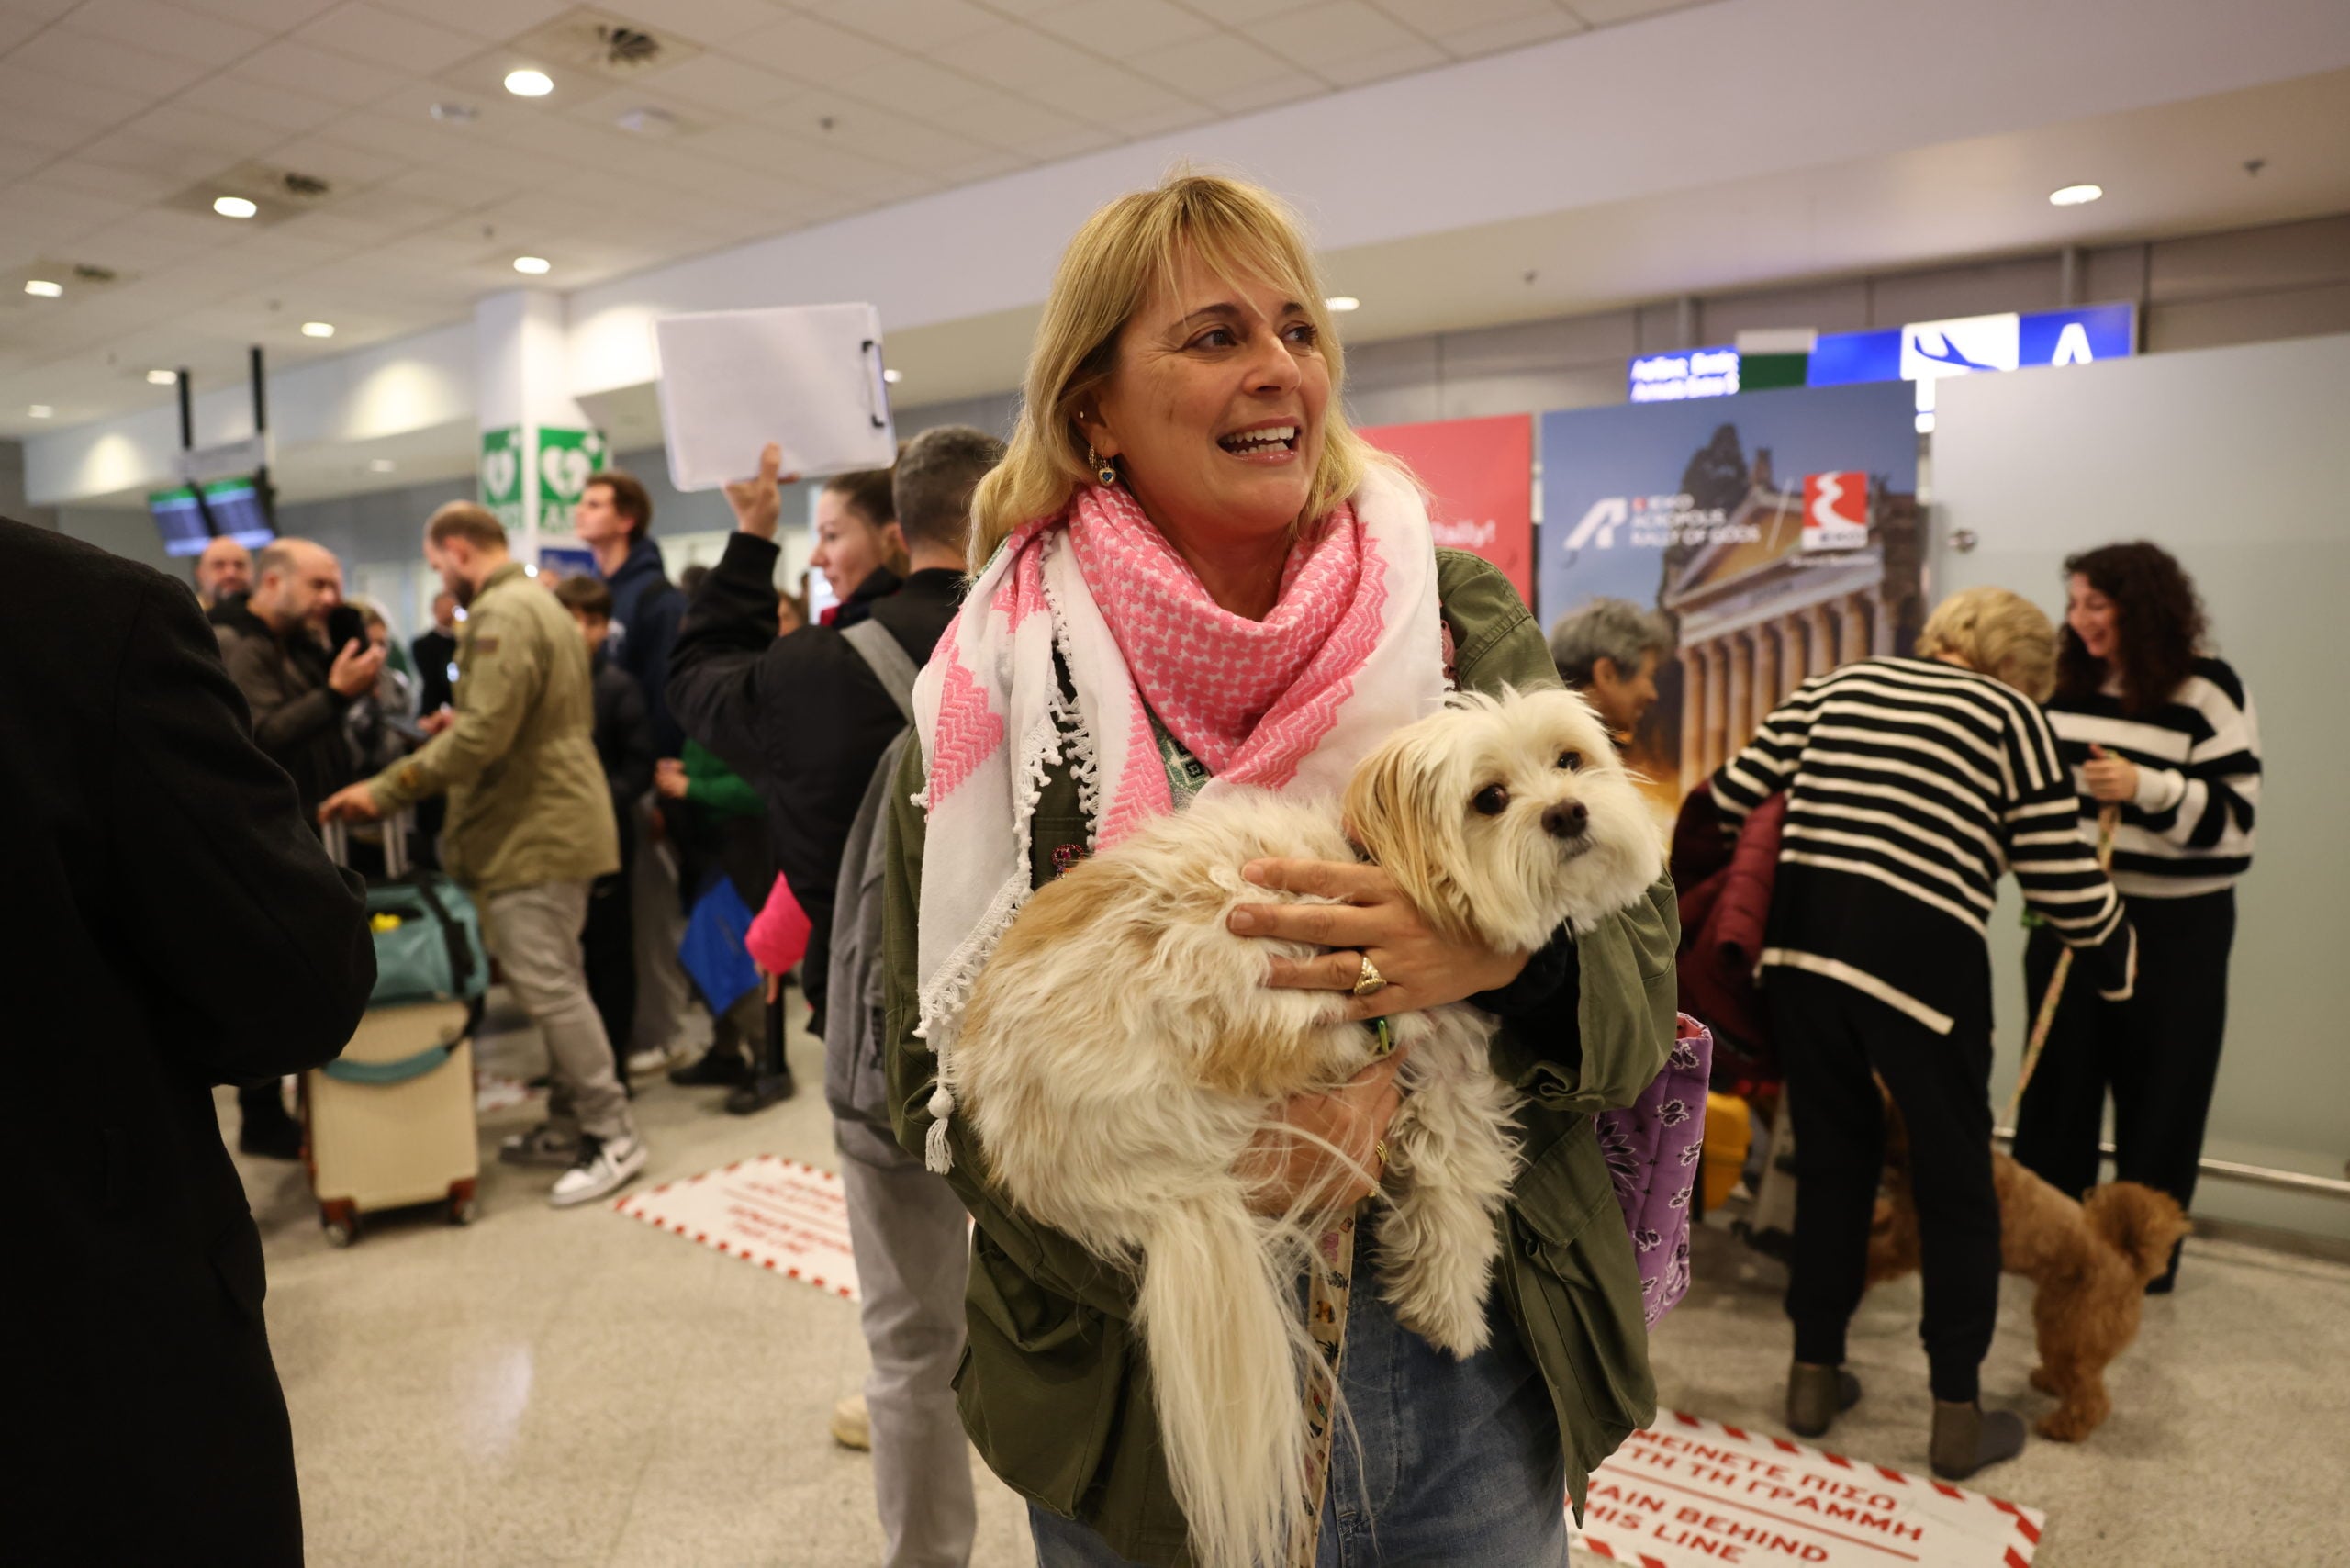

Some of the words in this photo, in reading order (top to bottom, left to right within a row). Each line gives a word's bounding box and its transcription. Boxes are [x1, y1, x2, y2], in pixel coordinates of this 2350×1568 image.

[1625, 1444, 1677, 1470] ΤΗ
[1690, 1464, 1738, 1488] ΤΗ
[1746, 1480, 1924, 1542] ΓΡΑΜΜΗ
[1631, 1428, 1790, 1482] ΜΕΙΝΕΤΕ
[1800, 1473, 1897, 1512] ΠΙΣΩ
[1653, 1523, 1747, 1564] LINE
[1675, 1506, 1829, 1563] BEHIND
